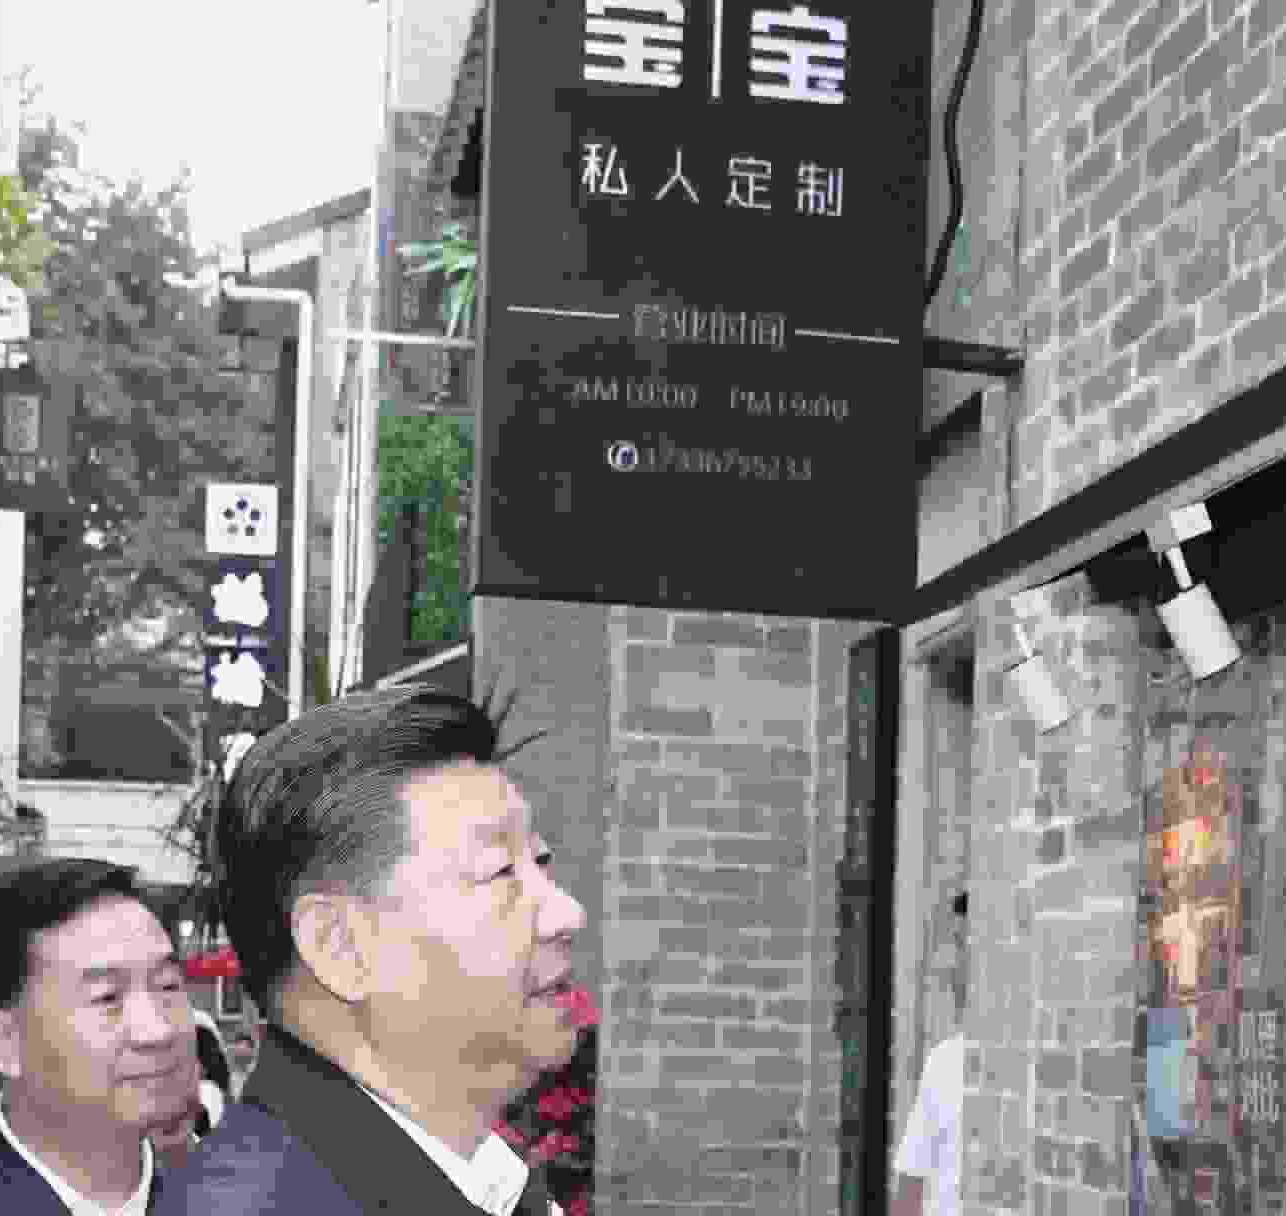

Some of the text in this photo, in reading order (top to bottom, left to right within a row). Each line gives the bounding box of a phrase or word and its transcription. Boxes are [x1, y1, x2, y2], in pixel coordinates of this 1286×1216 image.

[749, 4, 846, 104] 宝
[581, 143, 843, 215] 私人定制
